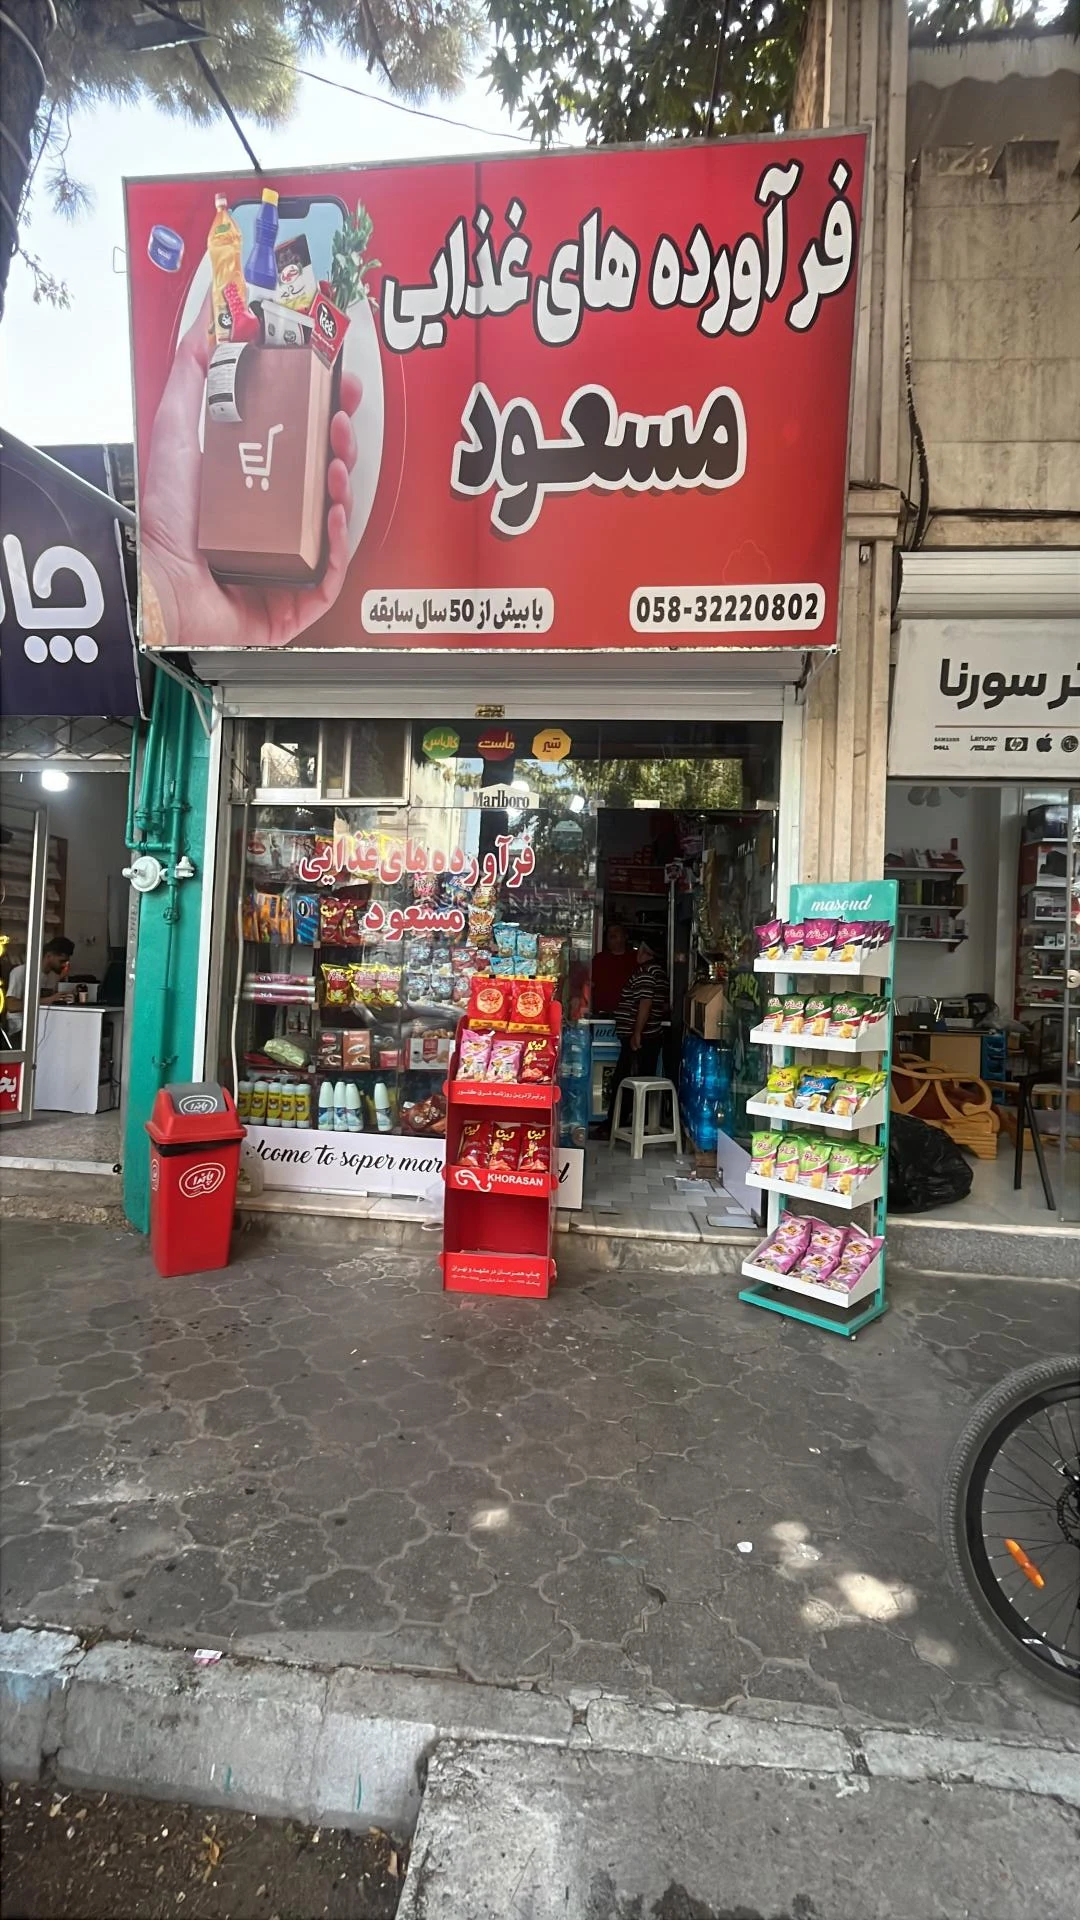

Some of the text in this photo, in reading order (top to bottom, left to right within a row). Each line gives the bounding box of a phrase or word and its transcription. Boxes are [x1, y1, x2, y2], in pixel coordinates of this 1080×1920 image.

[382, 196, 531, 352] غذایی
[533, 207, 640, 346] های
[450, 381, 748, 537] مسعود
[0, 533, 104, 664] چا
[369, 596, 544, 630] با بیش از 50 سال سابقه
[635, 592, 819, 624] 058-32220802
[939, 658, 1047, 710] سورنا
[423, 735, 460, 751] کالباس
[478, 731, 515, 750] ماست
[542, 737, 562, 752] شیر
[472, 790, 530, 808] Marlboro
[299, 830, 380, 885] غذایی
[379, 838, 427, 885] های
[810, 894, 873, 912] masoud
[364, 902, 465, 941] مسعود
[315, 1144, 338, 1166] to
[340, 1149, 396, 1176] soper
[398, 1156, 444, 1175] mar
[487, 1173, 544, 1187] KHORASAN
